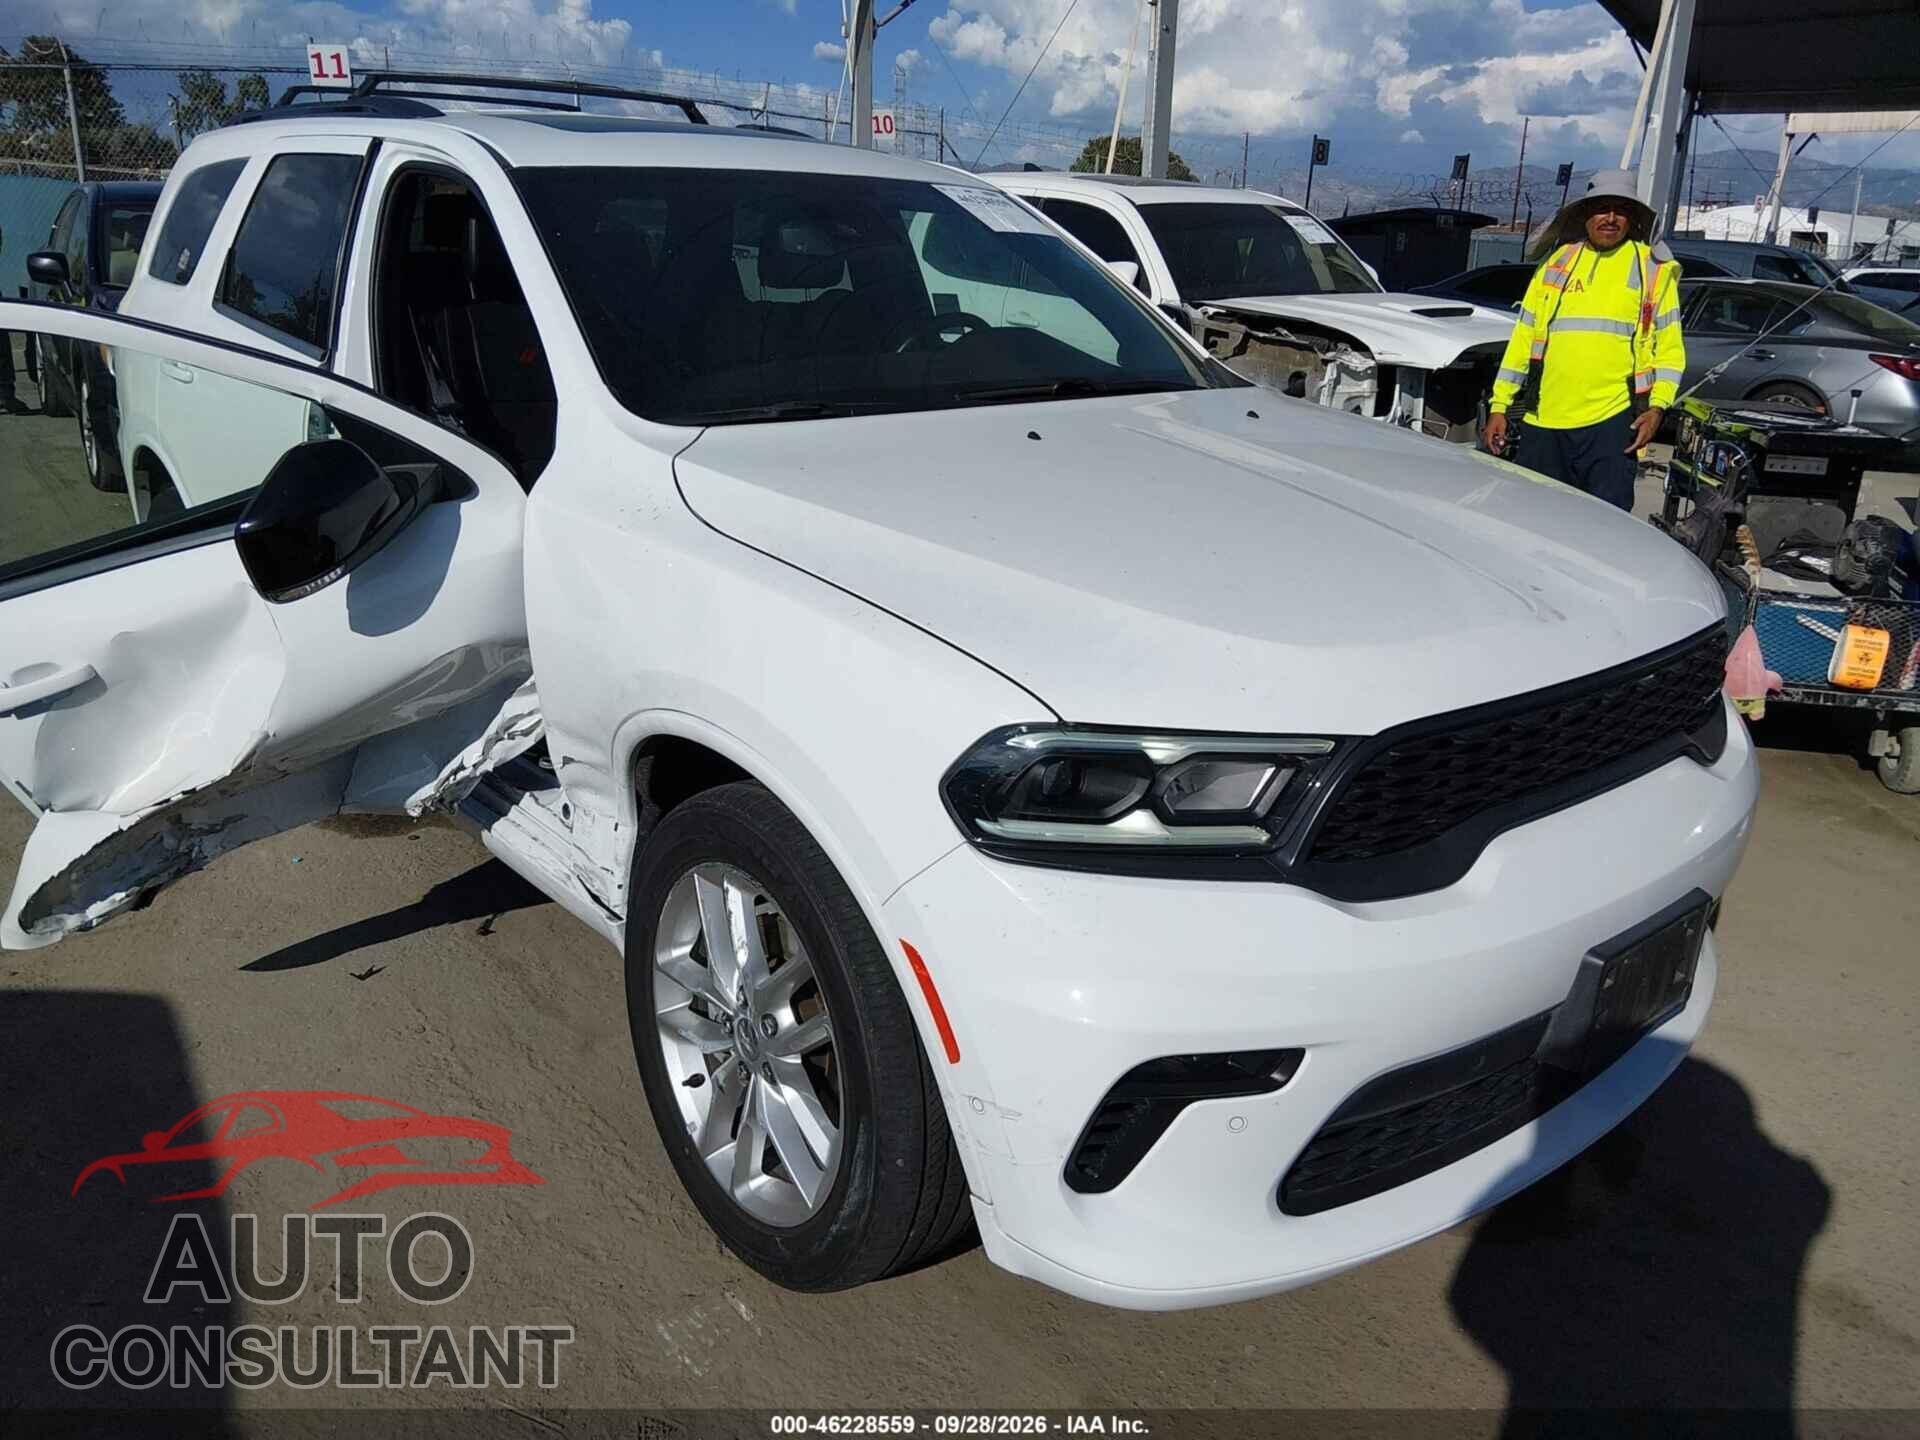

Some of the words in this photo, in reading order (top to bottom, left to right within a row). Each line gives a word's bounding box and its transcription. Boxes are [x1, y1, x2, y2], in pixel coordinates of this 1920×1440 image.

[311, 52, 348, 78] 11
[872, 115, 893, 134] 10
[1316, 142, 1325, 161] 8
